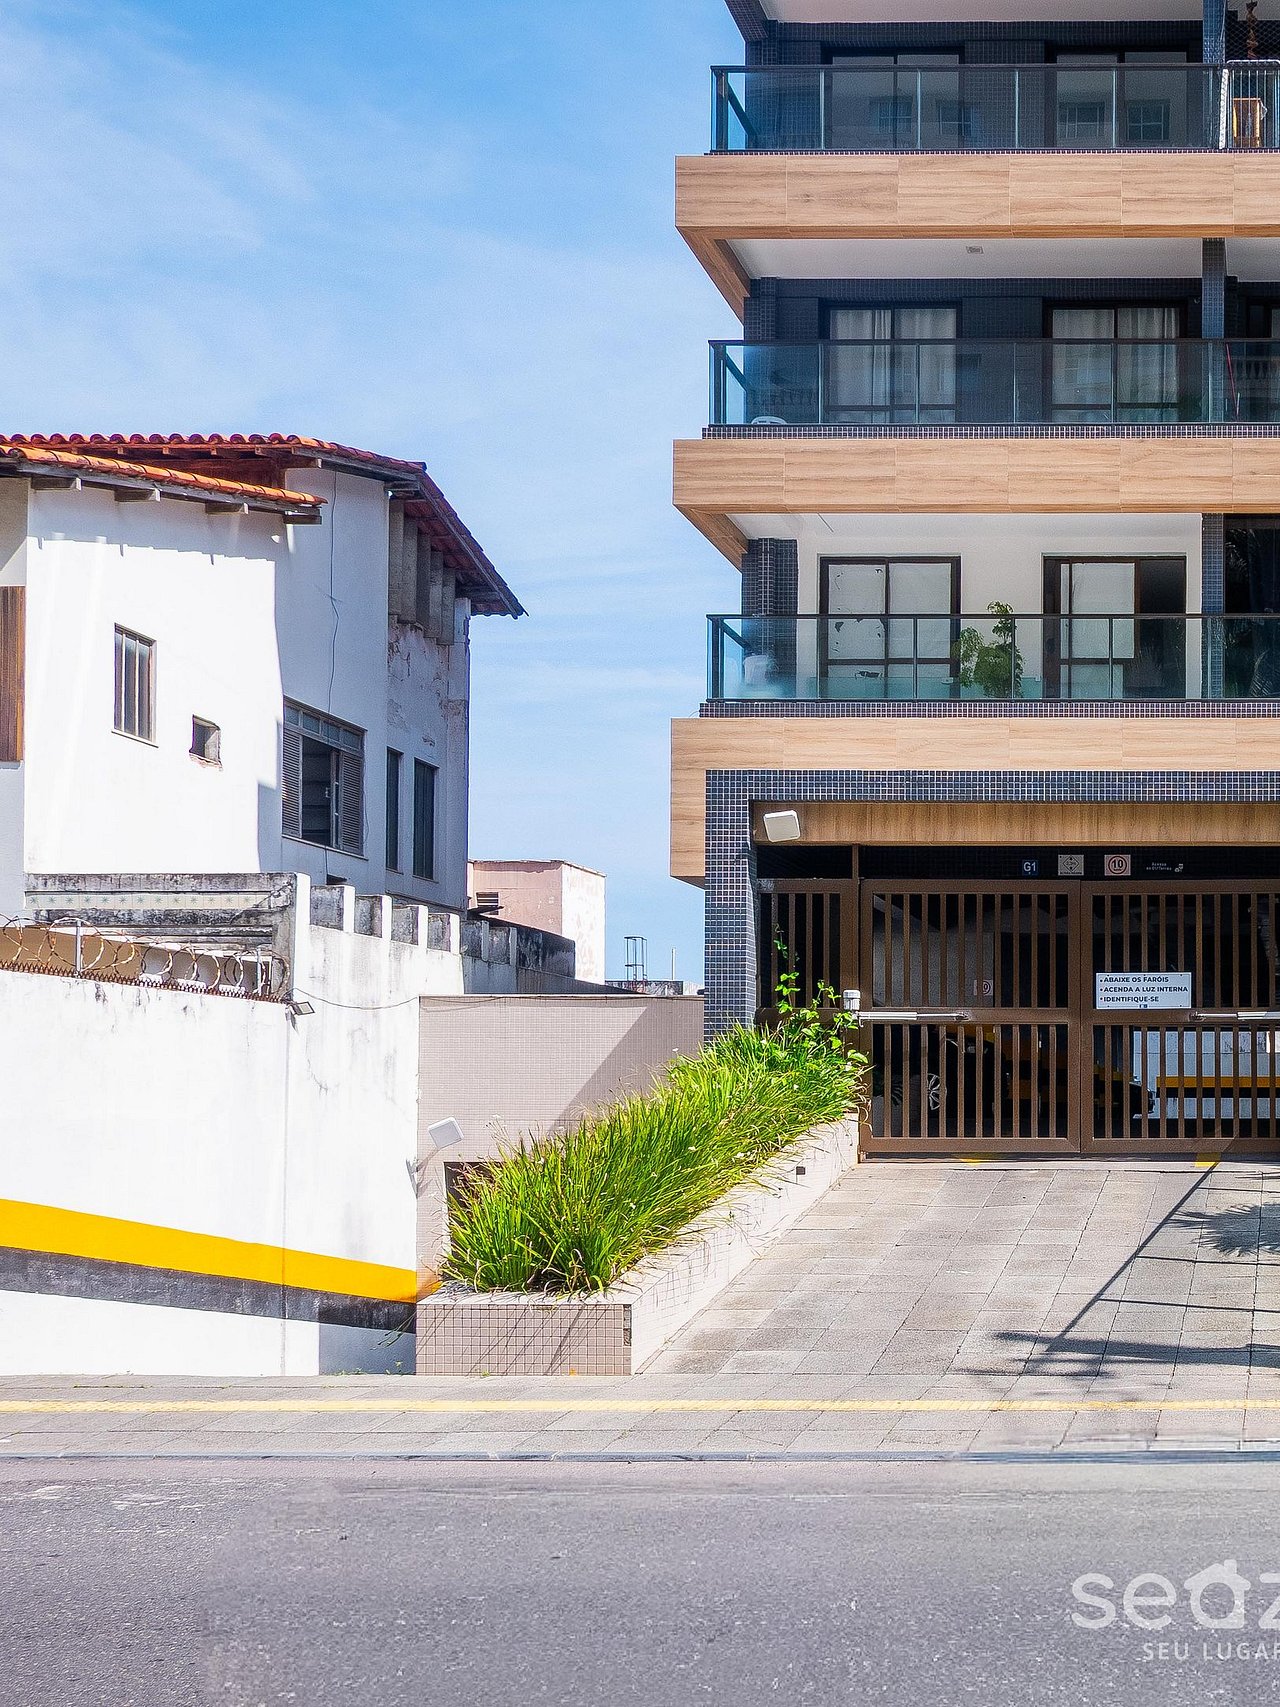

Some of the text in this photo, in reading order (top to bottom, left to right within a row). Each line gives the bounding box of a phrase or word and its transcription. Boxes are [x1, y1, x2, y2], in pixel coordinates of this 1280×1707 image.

[1023, 861, 1036, 871] G1
[1112, 859, 1123, 869] 10
[1143, 975, 1169, 983] FARÓIS
